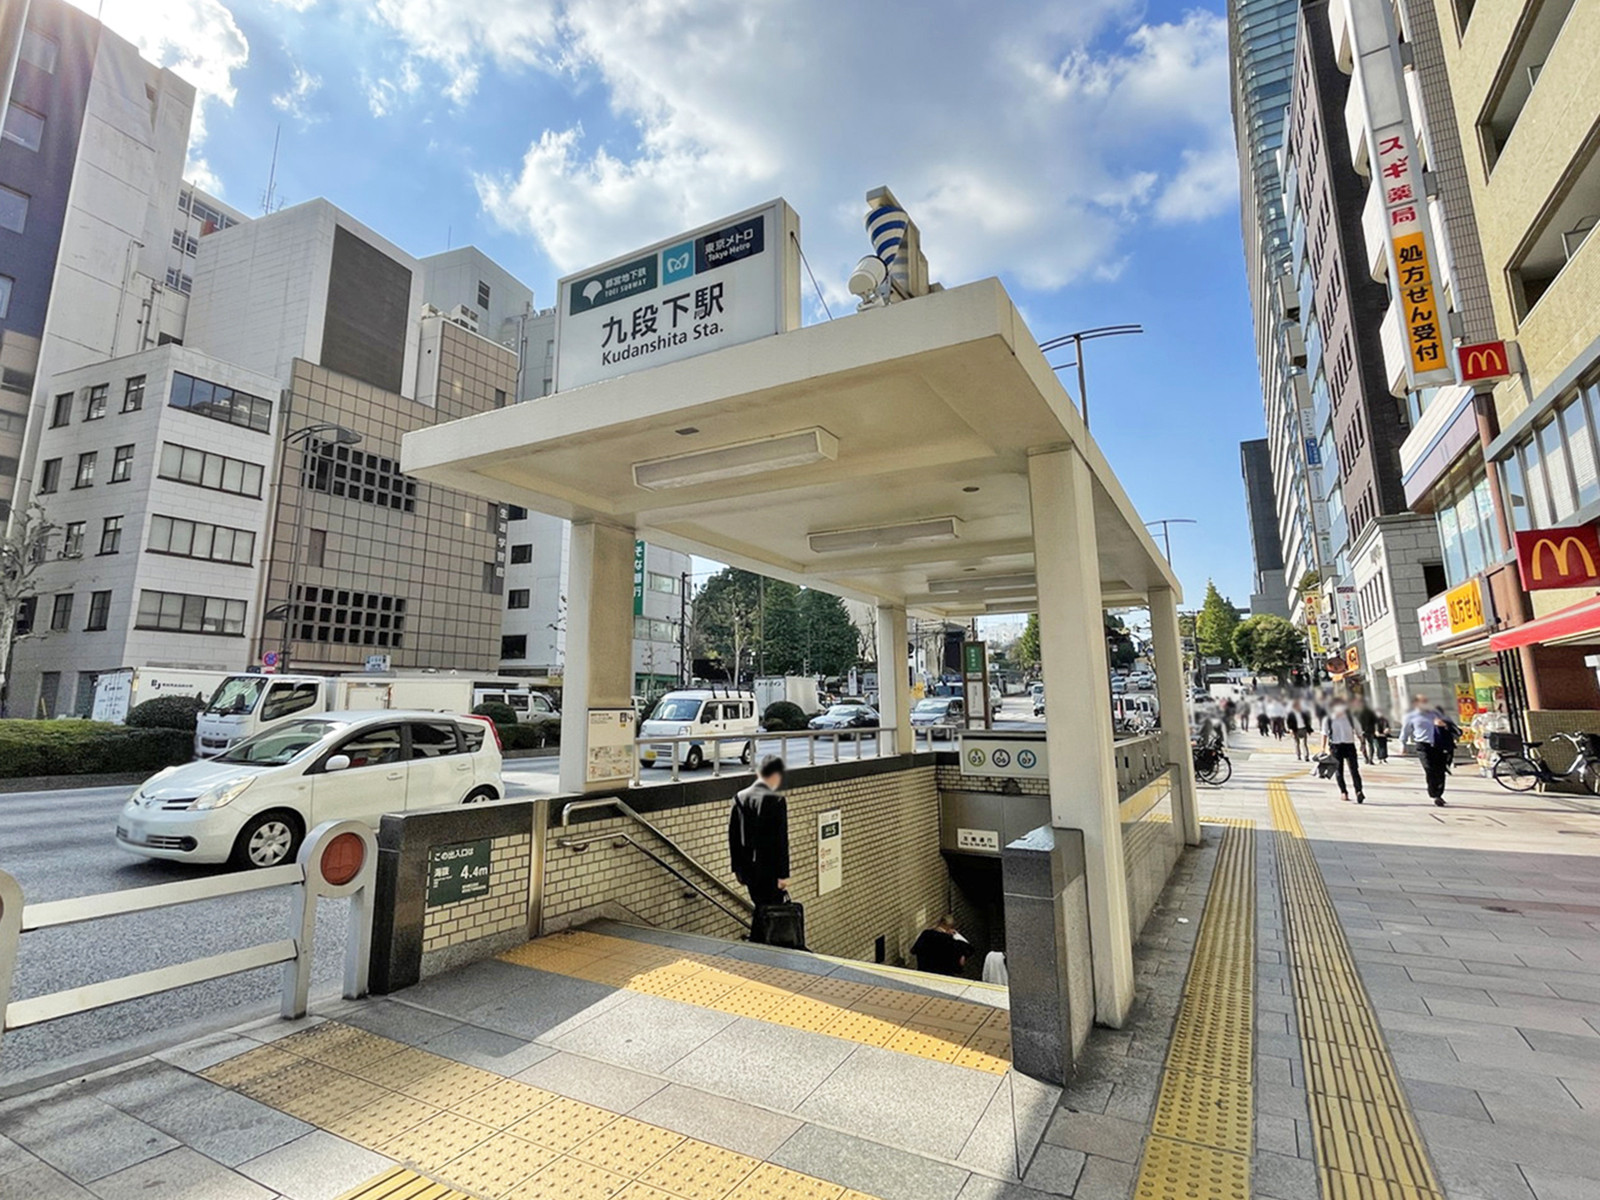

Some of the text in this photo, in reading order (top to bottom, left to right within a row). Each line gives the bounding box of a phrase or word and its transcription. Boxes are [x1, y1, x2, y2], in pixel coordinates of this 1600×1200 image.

[1379, 136, 1417, 226] スギ薬局
[705, 228, 753, 254] 東京メトロ
[707, 241, 751, 263] Tokyo Metro
[604, 266, 647, 289] 都営地下鉄
[604, 277, 647, 298] TOEI SUBWAY
[601, 281, 724, 349] 九段下駅
[1399, 244, 1439, 362] 処方せん受付
[601, 321, 724, 366] Kudanshita Sta.
[460, 865, 488, 879] 4.4m
